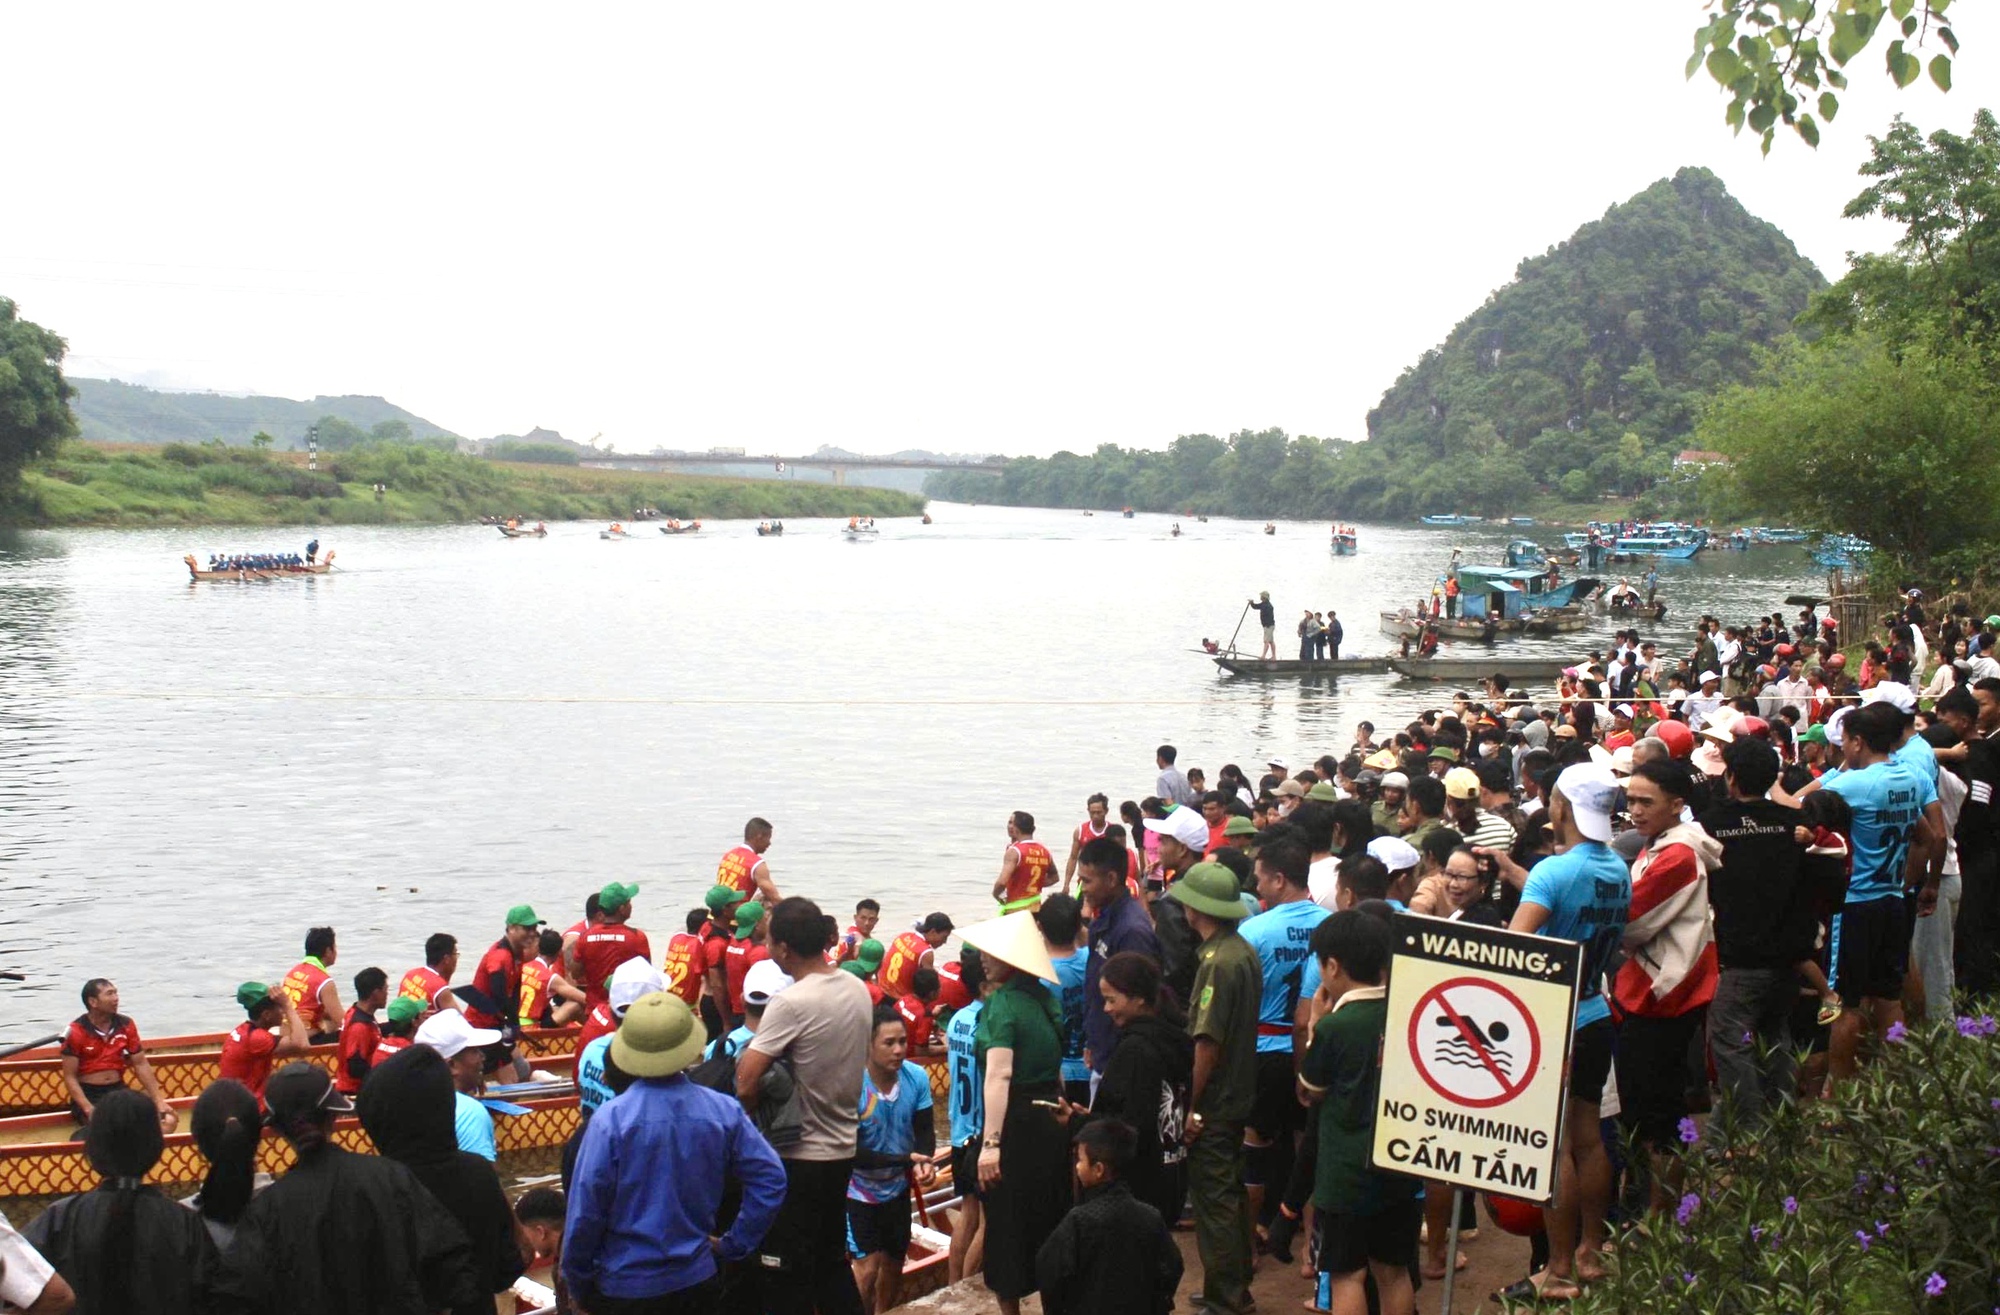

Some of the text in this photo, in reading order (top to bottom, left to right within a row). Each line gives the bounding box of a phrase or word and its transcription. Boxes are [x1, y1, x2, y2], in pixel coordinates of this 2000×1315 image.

[1911, 787, 1917, 802] 2
[1026, 865, 1041, 892] 2
[1620, 879, 1628, 900] 2
[886, 951, 903, 983] 8
[1274, 946, 1310, 964] Phon
[1421, 932, 1547, 973] WARNING
[1384, 1099, 1548, 1150] NO SWIMMING
[1387, 1135, 1538, 1191] CẤM TẮM
